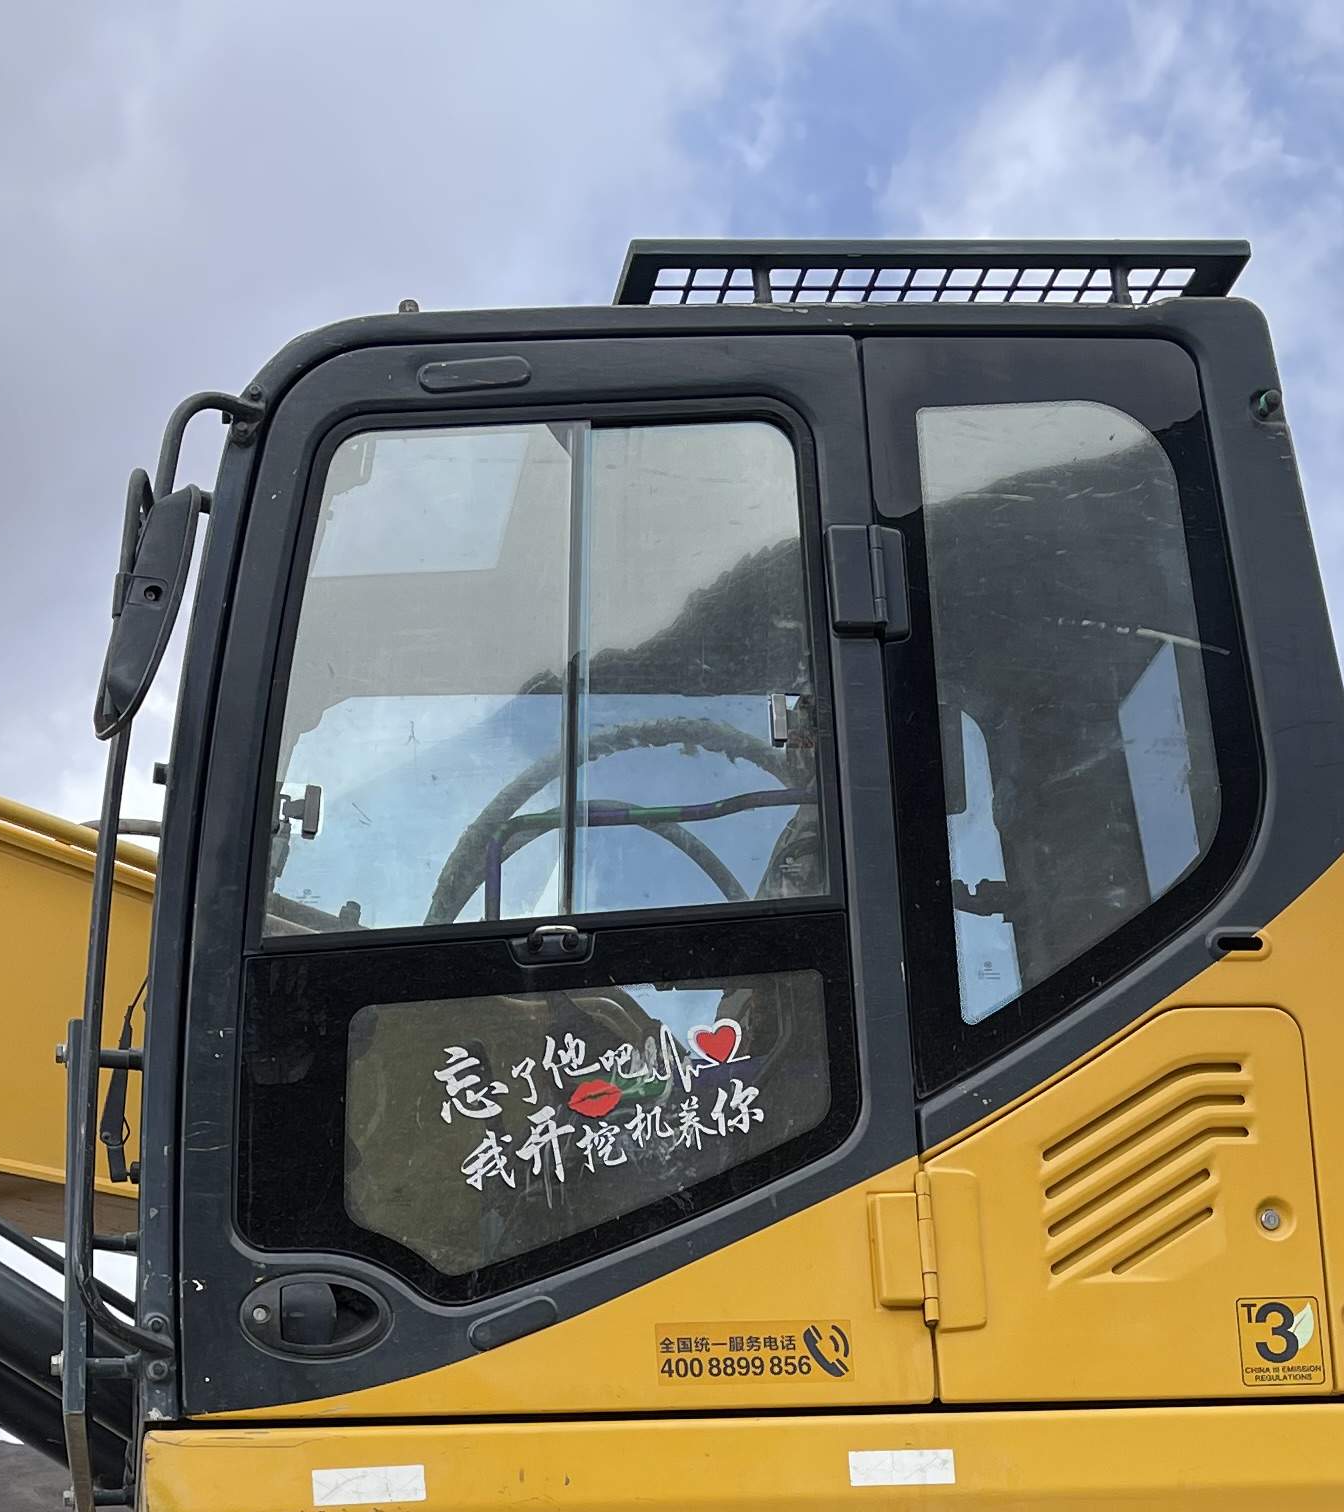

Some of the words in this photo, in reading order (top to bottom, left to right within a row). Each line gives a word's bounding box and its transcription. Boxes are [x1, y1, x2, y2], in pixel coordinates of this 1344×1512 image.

[433, 1032, 648, 1124] 忘了他吧
[460, 1078, 765, 1191] 我开挖机养你
[659, 1335, 797, 1353] 全国统一服务电话
[660, 1357, 704, 1378] 400
[708, 1356, 765, 1377] 8899
[769, 1355, 812, 1376] 856
[1255, 1373, 1312, 1381] REGULATIONS
